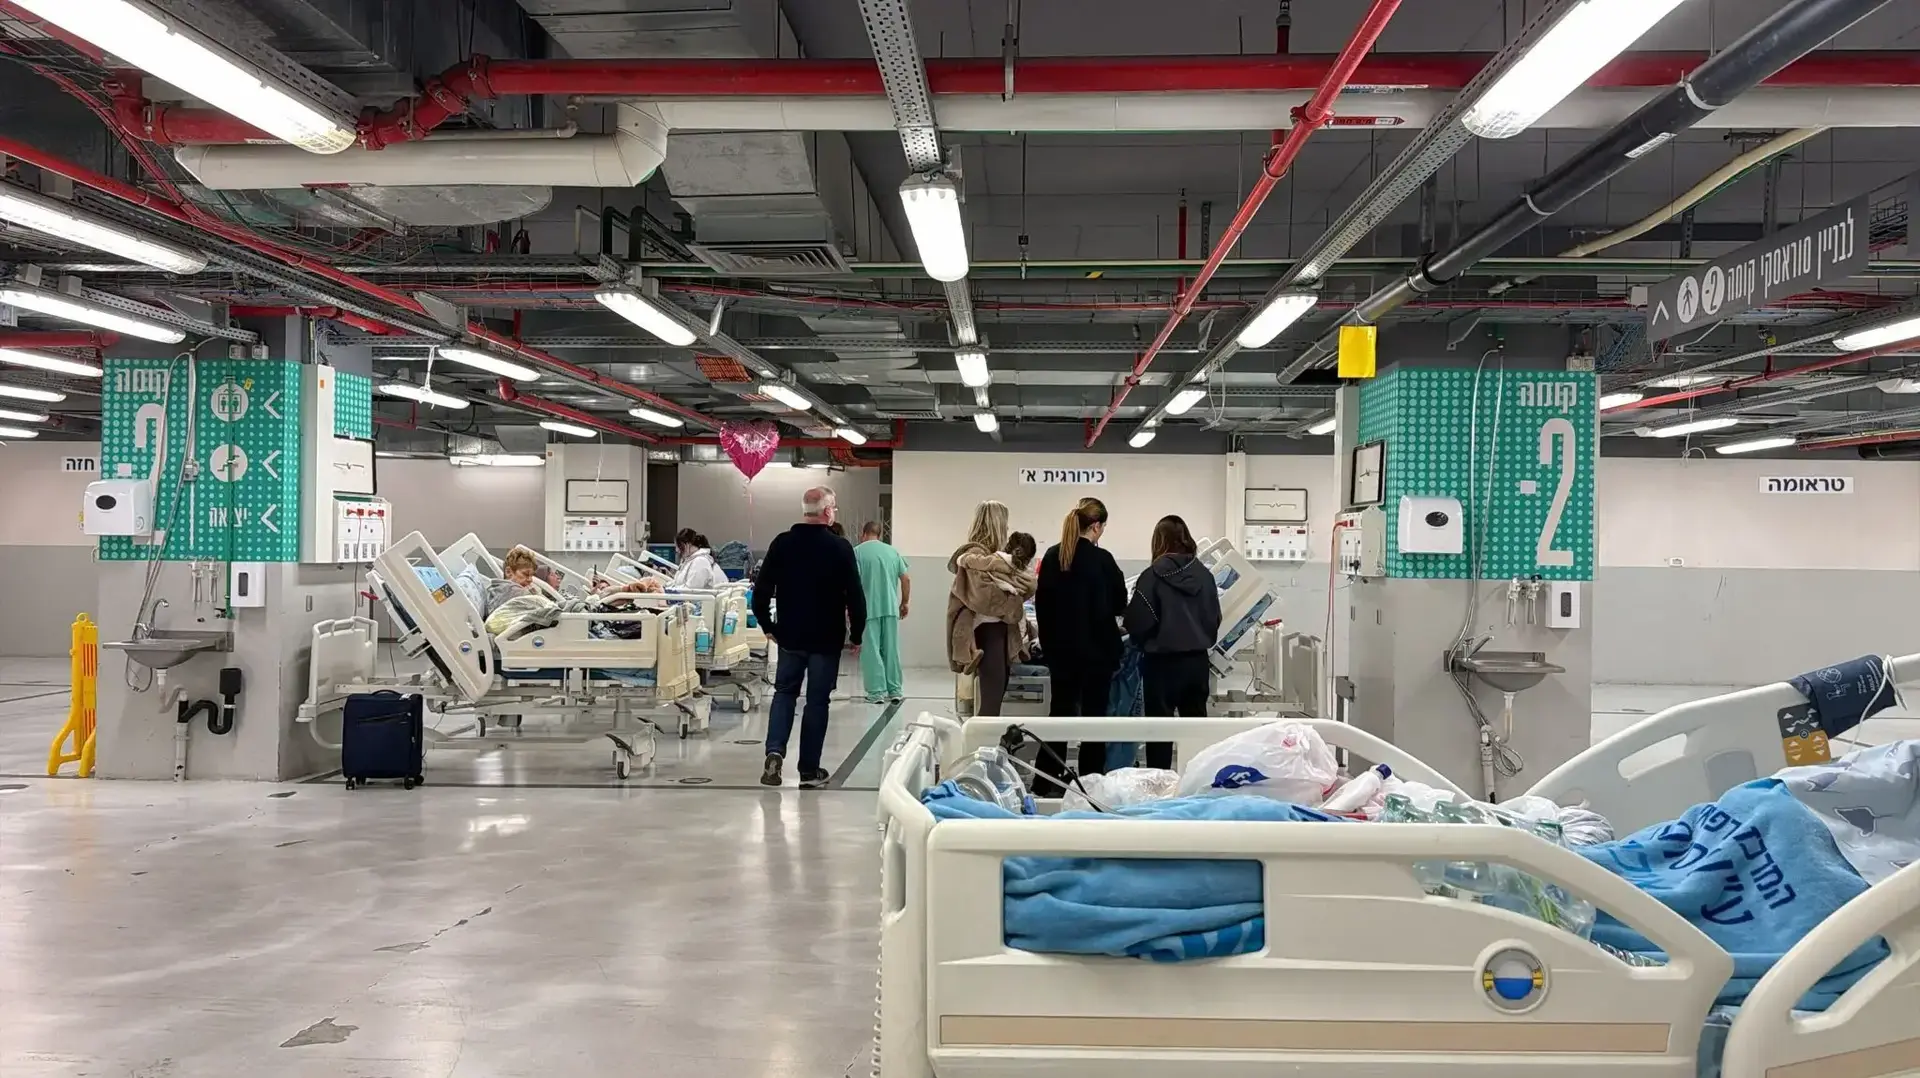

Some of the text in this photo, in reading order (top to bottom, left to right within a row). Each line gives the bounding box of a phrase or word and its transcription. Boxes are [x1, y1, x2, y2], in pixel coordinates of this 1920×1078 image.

[1817, 207, 1854, 280] לבניין
[1727, 258, 1755, 305] קומה
[1760, 235, 1812, 299] סוראסקי
[115, 368, 169, 400] קומה
[1519, 381, 1577, 414] קומה
[66, 458, 95, 471] חזה
[1043, 470, 1105, 483] כירורגית
[1768, 478, 1845, 492] טראומה
[208, 507, 248, 528] יצאה
